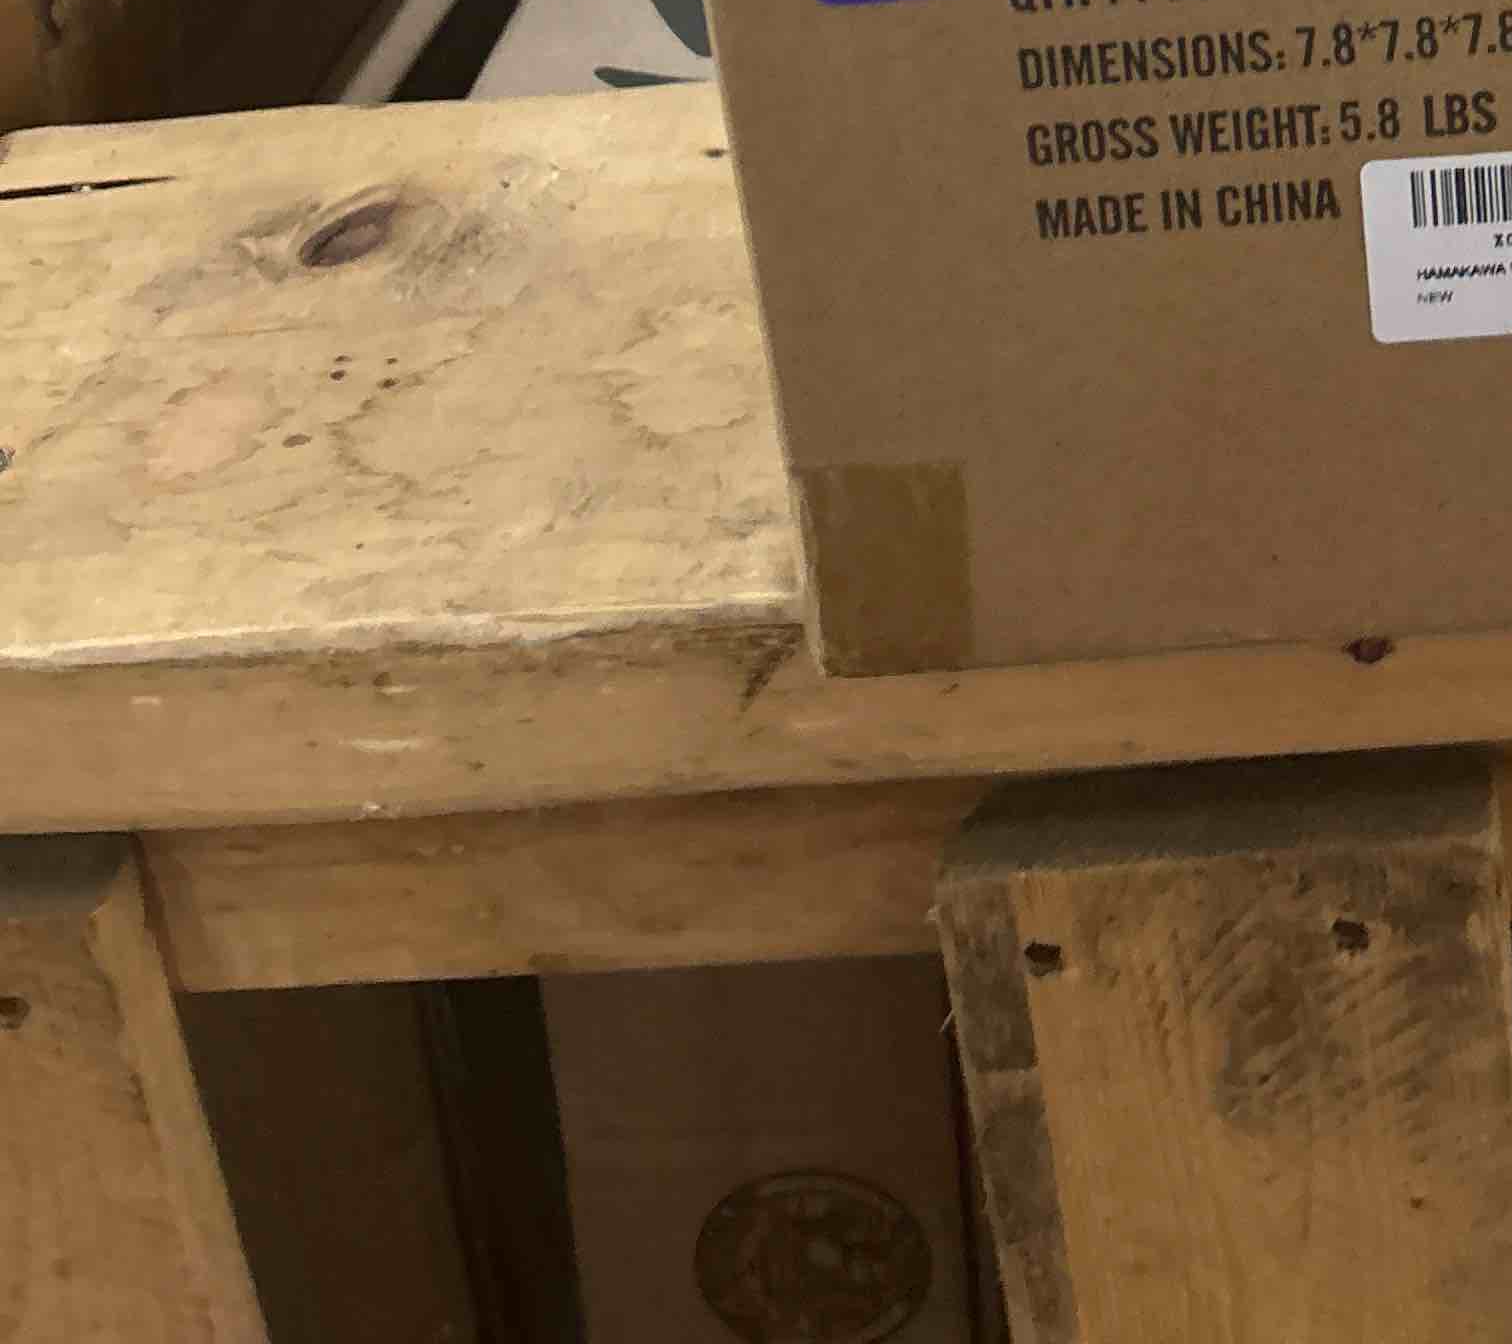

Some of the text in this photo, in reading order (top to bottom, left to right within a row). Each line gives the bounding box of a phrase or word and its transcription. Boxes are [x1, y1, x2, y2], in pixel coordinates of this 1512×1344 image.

[1017, 29, 1286, 90] DIMENSIONS:
[1026, 90, 1497, 168] GROSS WEIGHT: 5.8 LBS
[1035, 177, 1342, 240] MADE IN CHINA
[1416, 262, 1506, 281] HAMAKAWA
[1416, 289, 1454, 305] NEW
